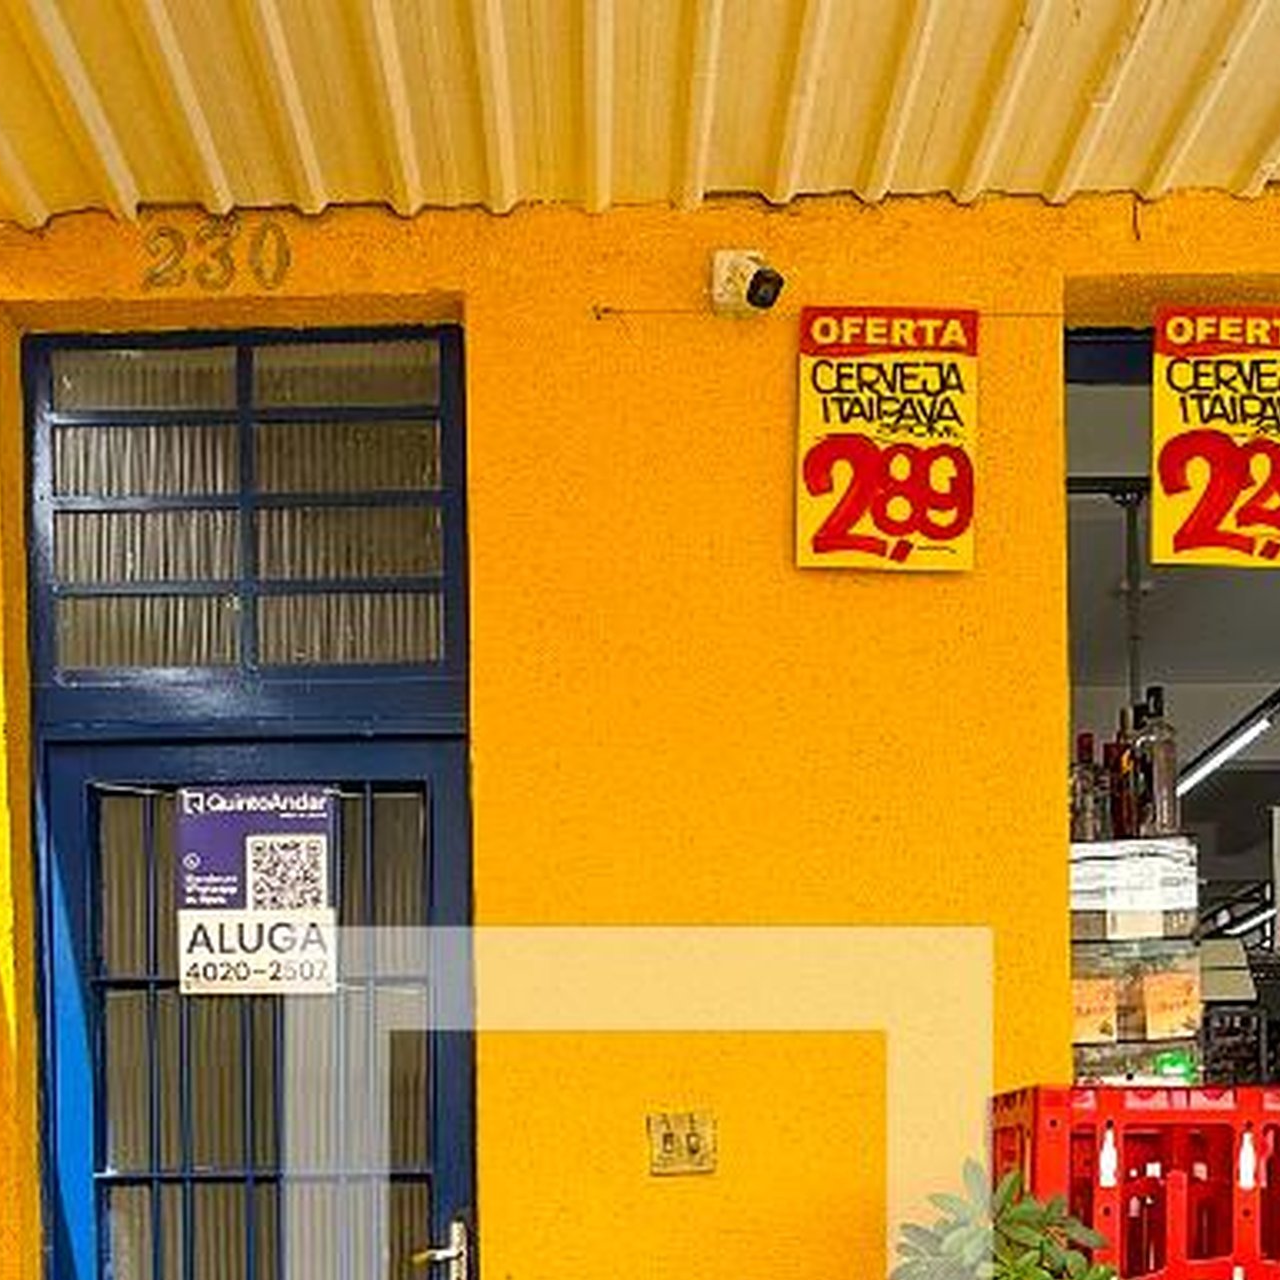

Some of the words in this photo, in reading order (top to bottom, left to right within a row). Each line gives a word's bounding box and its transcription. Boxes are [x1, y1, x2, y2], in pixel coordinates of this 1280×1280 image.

[143, 212, 291, 291] 230
[811, 316, 967, 348] OFERTA
[811, 359, 965, 396] CERVEJA
[822, 396, 964, 427] ITAIPAVA
[186, 923, 327, 955] ALUGA
